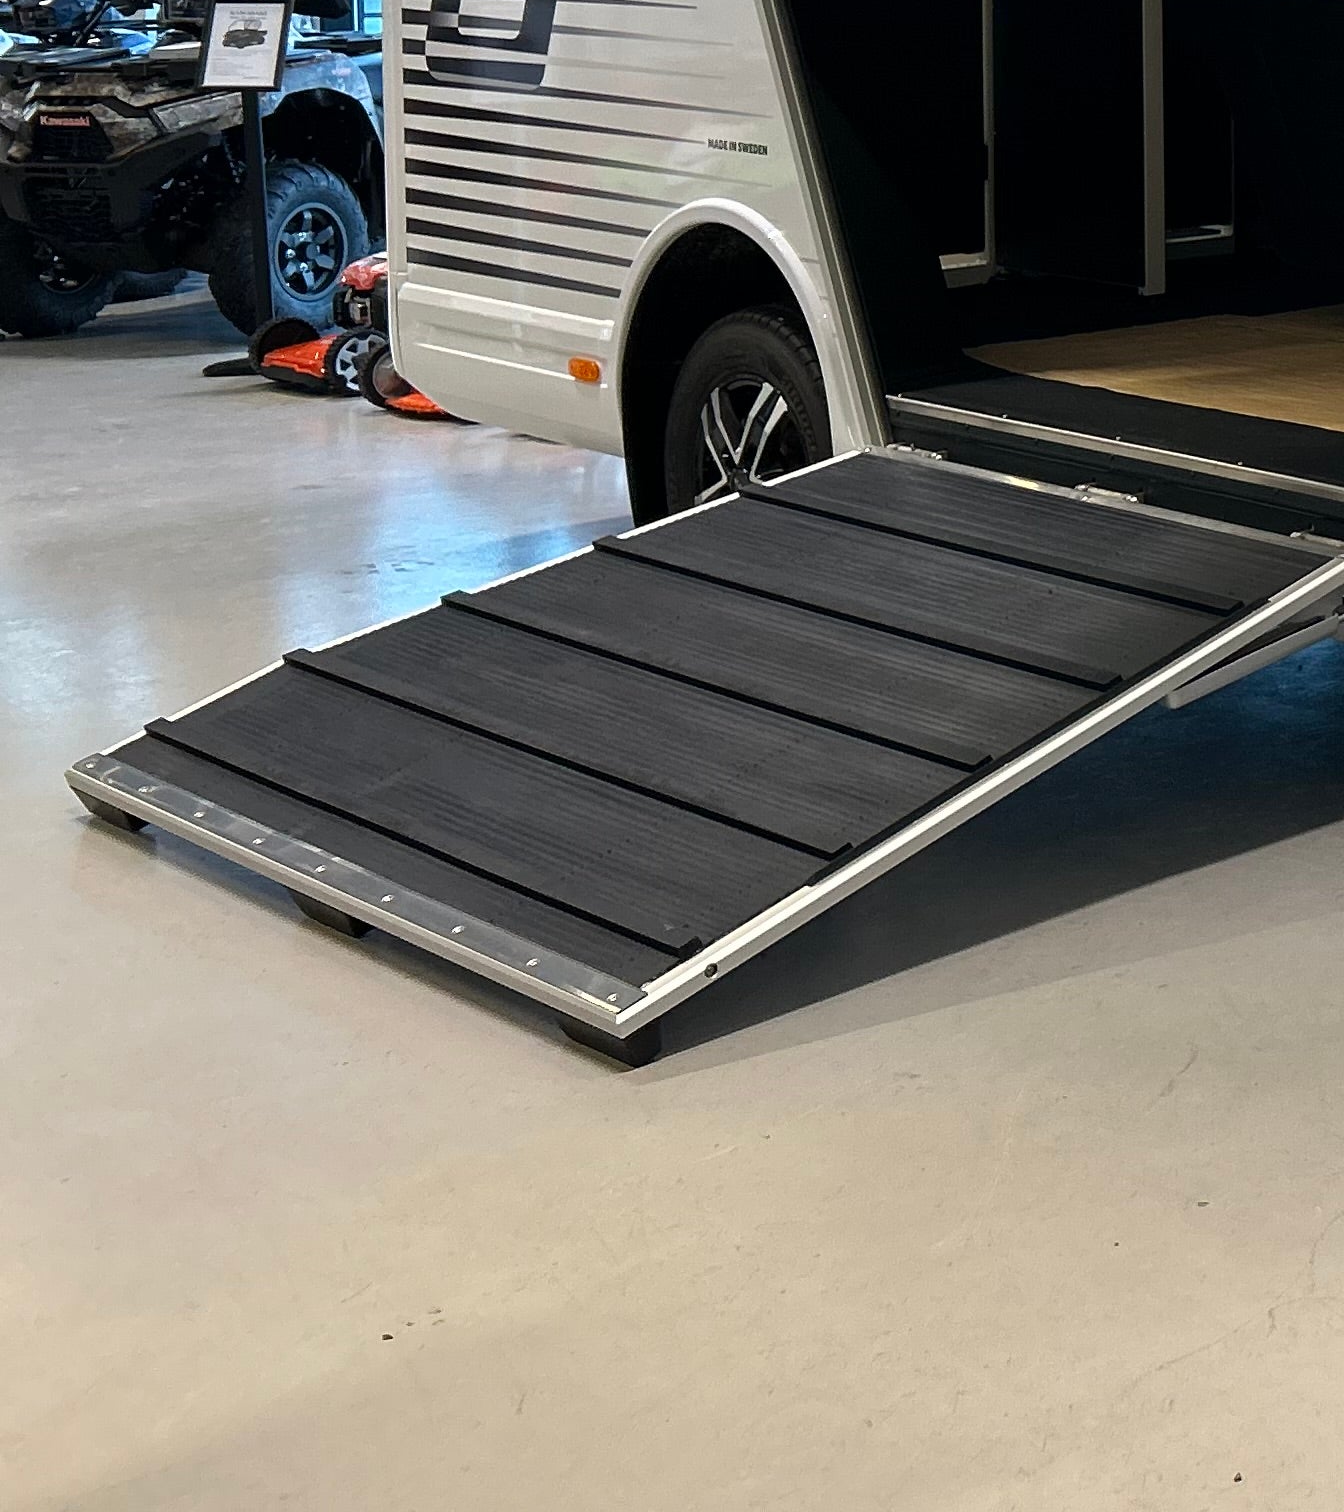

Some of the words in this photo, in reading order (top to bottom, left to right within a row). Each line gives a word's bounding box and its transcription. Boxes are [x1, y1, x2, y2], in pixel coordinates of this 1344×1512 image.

[707, 138, 728, 151] MADE
[728, 141, 737, 152] IN
[737, 142, 768, 156] SWEDEN
